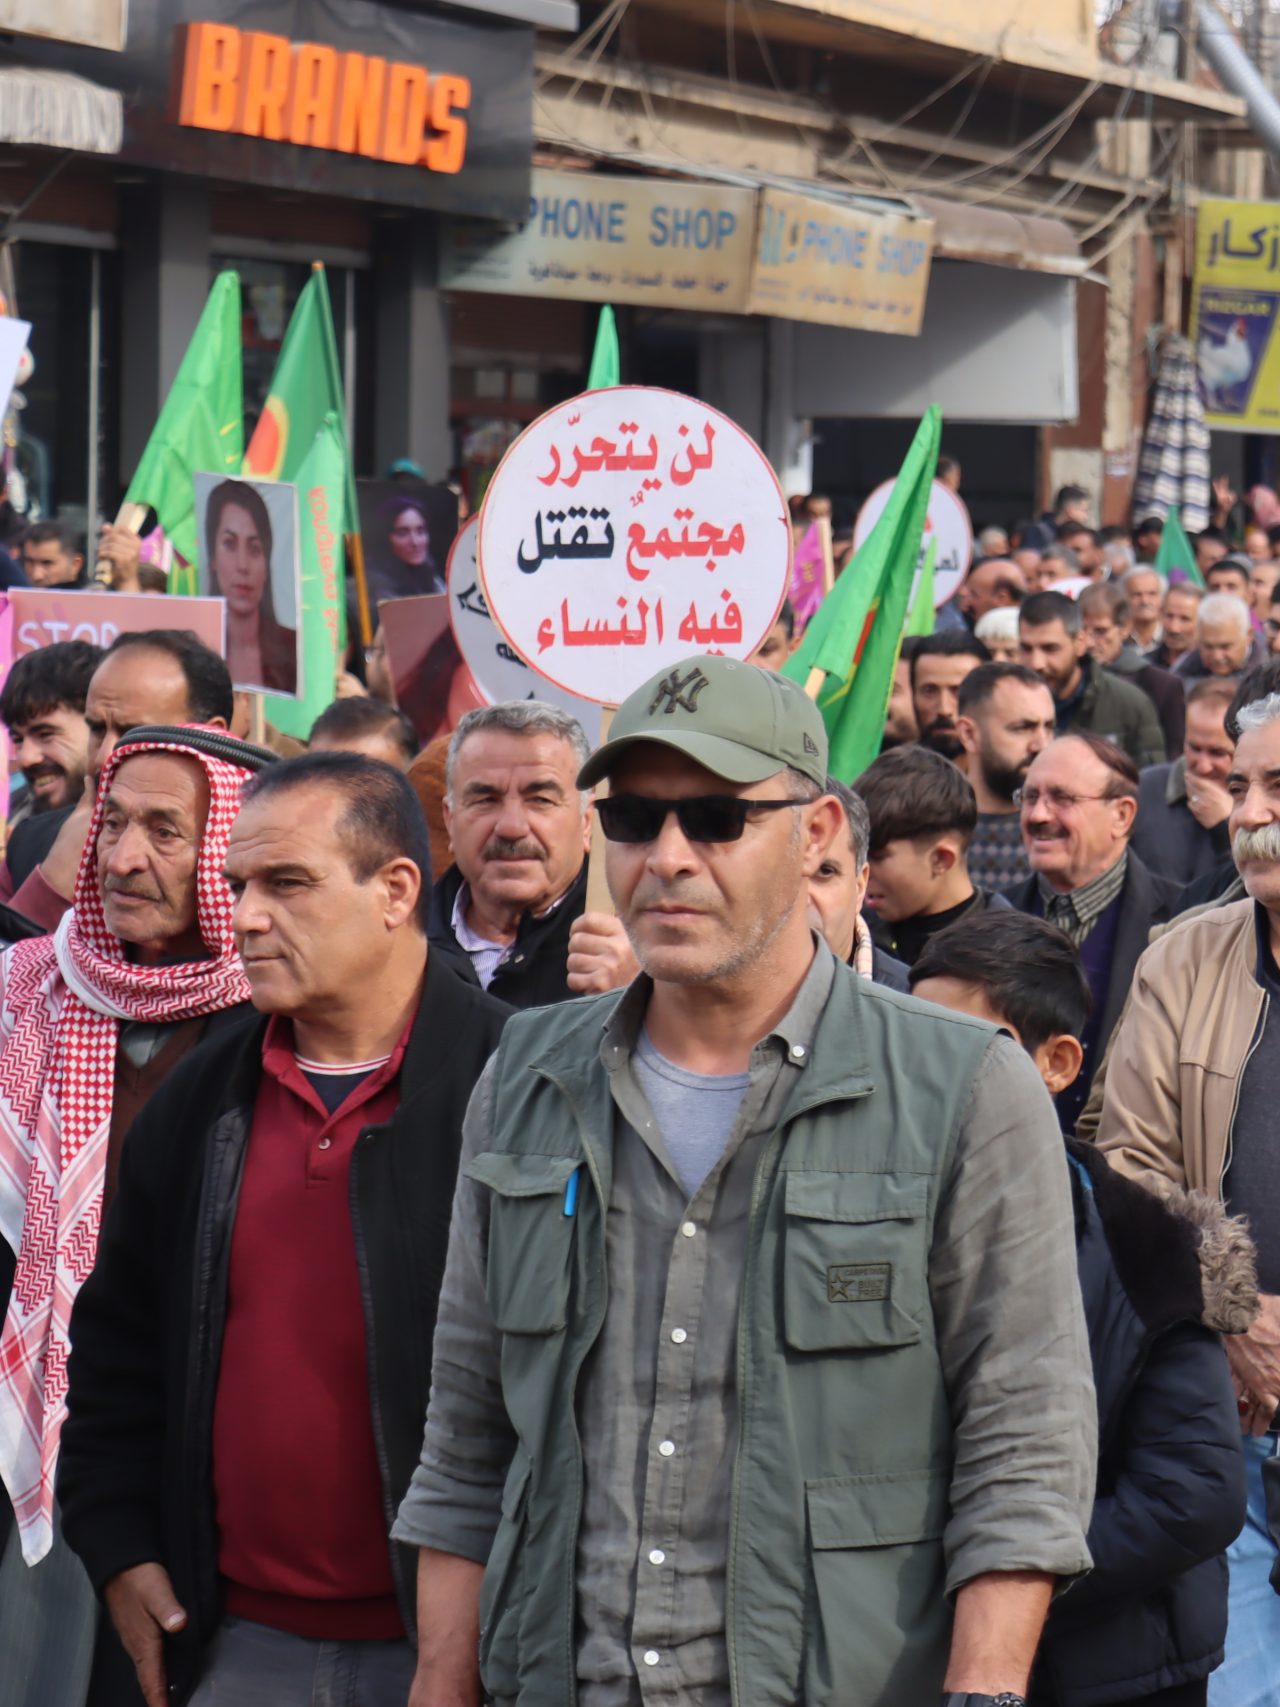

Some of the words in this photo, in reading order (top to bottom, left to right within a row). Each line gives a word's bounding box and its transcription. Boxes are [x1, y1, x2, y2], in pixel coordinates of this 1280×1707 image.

[180, 20, 471, 174] BRANDS
[649, 206, 736, 250] SHOP
[803, 219, 869, 270] PHONE
[669, 420, 716, 486] لن
[516, 505, 615, 574] تقتل
[536, 595, 664, 656] النساء
[677, 588, 744, 656] فيه
